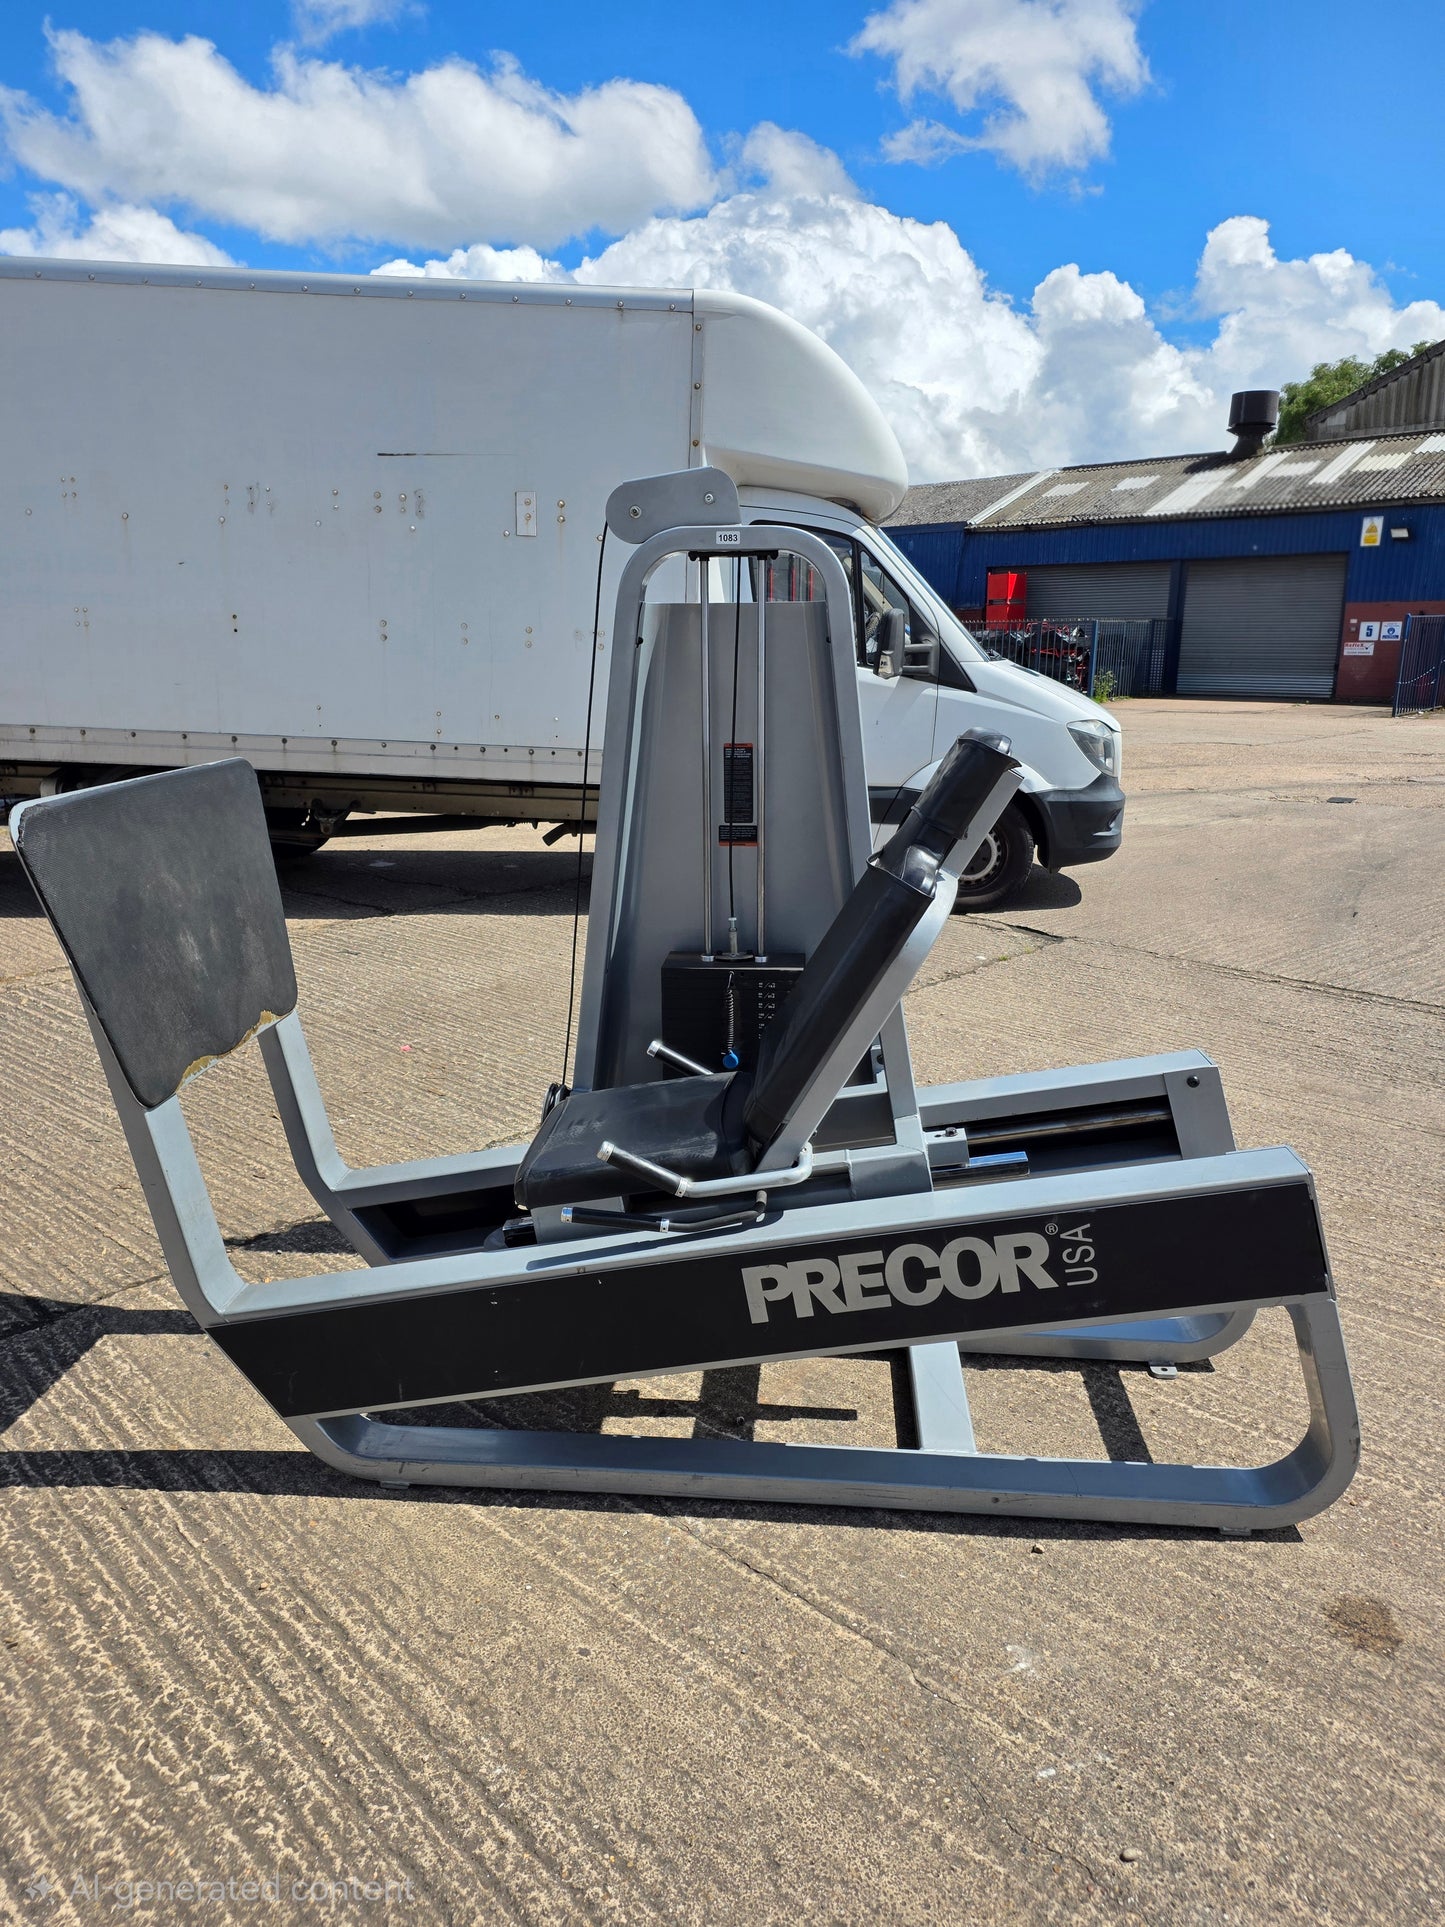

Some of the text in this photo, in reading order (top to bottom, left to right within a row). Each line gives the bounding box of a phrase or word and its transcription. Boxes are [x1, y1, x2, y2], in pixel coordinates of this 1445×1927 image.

[719, 534, 738, 542] 1083
[1366, 625, 1373, 637] 5
[1060, 1223, 1098, 1287] USA
